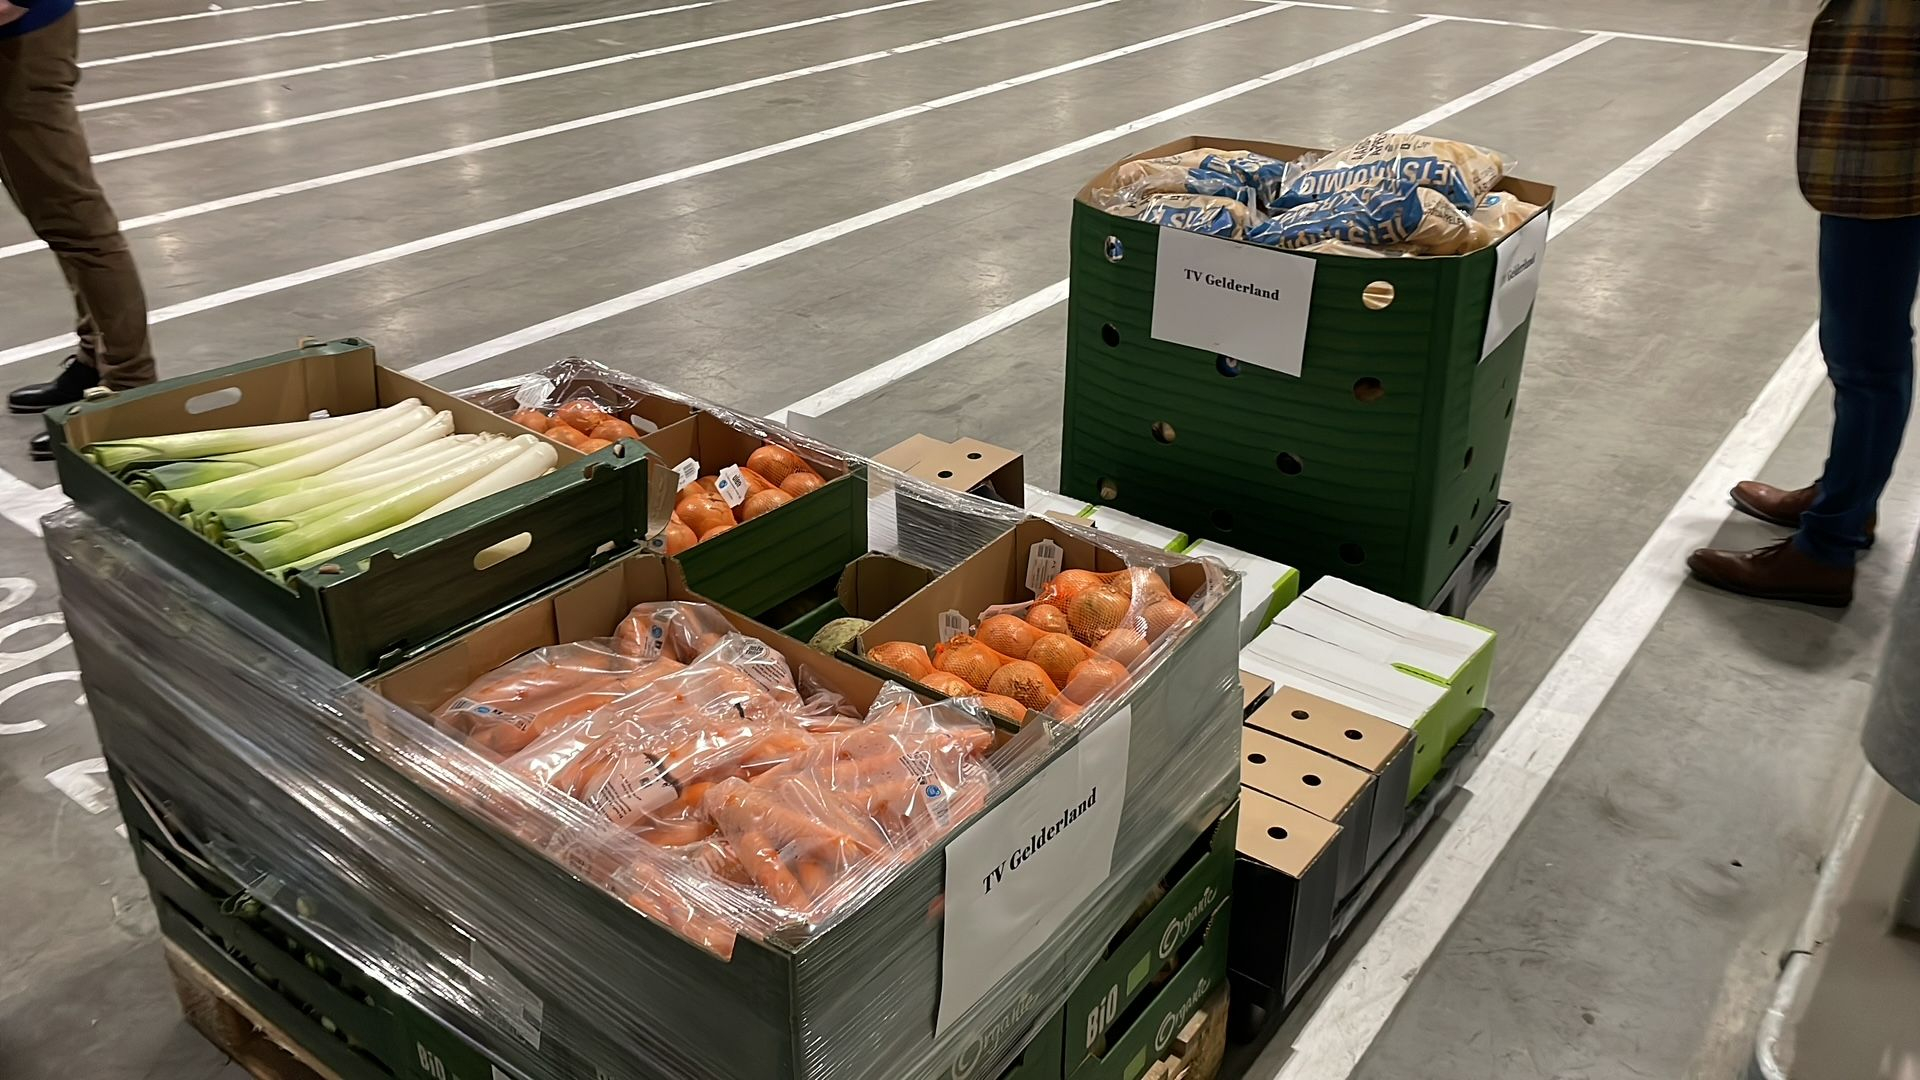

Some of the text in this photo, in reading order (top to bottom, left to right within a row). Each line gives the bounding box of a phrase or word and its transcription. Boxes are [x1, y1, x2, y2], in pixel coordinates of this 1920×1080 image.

[1183, 267, 1280, 301] TV Gelderland
[982, 860, 1007, 895] TV
[1009, 786, 1097, 871] Gelderland
[1159, 886, 1218, 959] Organic
